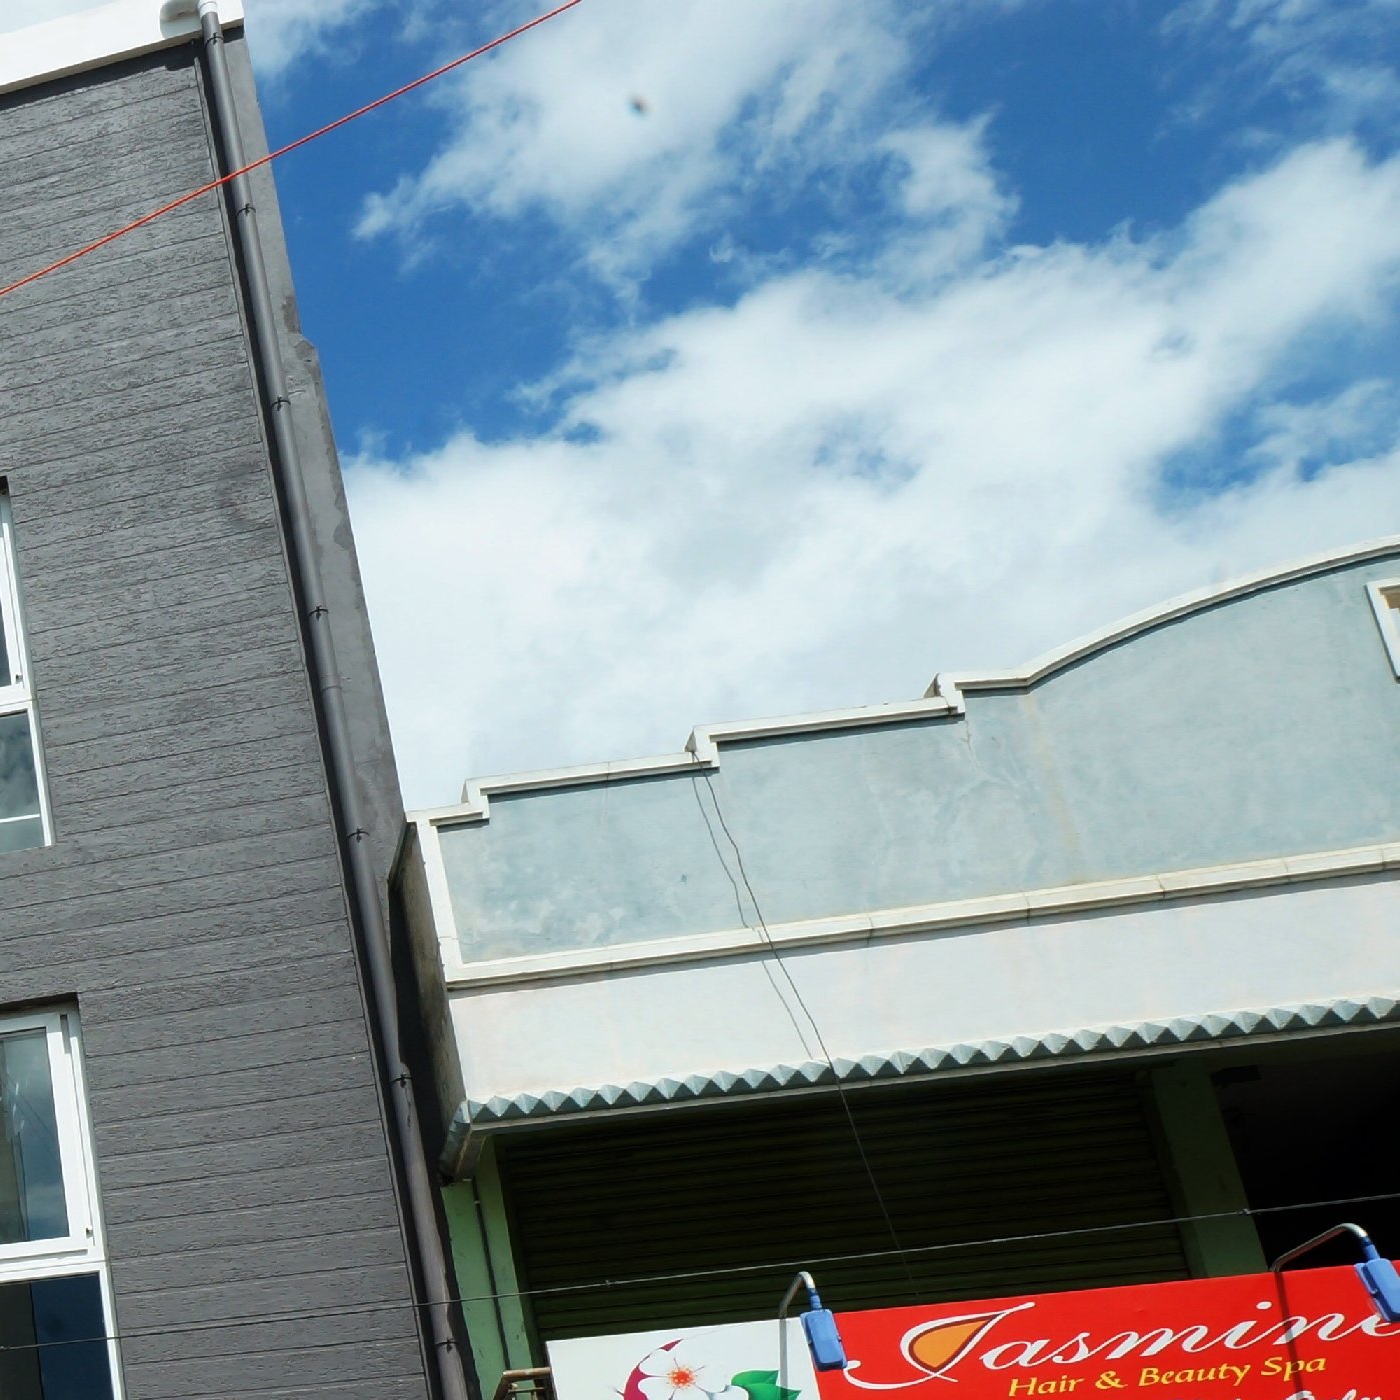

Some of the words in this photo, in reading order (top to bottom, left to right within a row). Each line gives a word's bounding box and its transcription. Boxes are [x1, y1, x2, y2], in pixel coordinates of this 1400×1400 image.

[1009, 1371, 1084, 1397] Hair
[1095, 1371, 1128, 1389] &
[1139, 1363, 1251, 1387] Beauty
[1261, 1356, 1328, 1382] Spa
